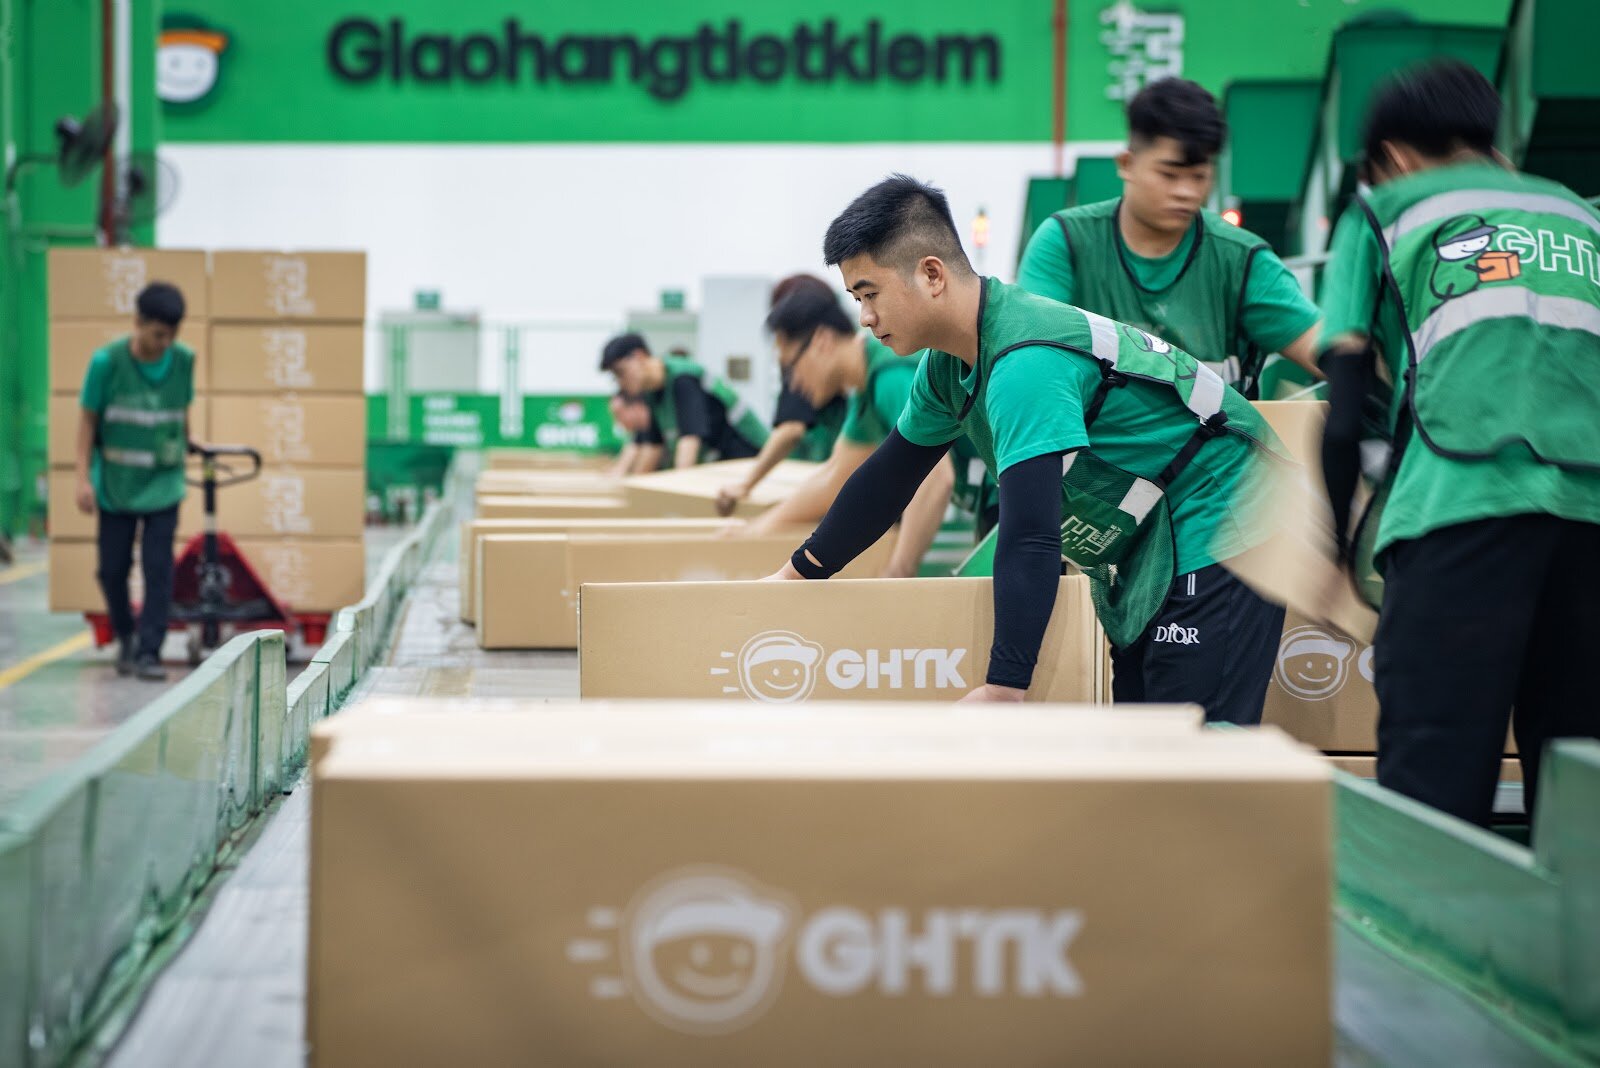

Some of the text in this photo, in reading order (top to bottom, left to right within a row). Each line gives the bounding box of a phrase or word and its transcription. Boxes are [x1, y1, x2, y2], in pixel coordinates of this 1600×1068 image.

[1154, 622, 1200, 645] DIOR
[826, 648, 967, 690] GHTK
[797, 907, 1085, 997] GHTK
